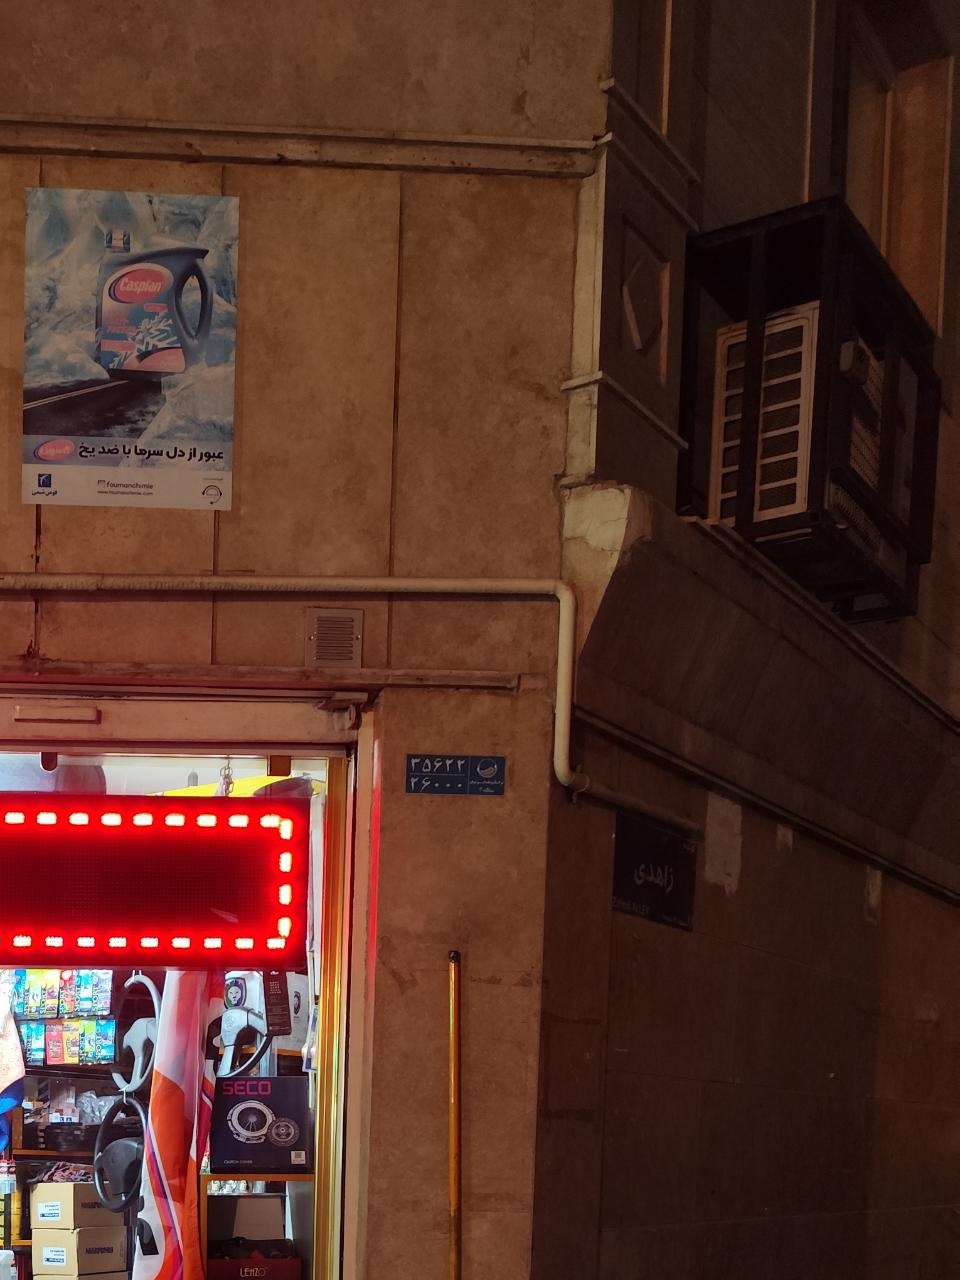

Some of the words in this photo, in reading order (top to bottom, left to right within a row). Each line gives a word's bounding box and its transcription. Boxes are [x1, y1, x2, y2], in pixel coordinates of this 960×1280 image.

[119, 277, 163, 295] Caspian
[78, 442, 95, 458] یخ
[98, 444, 119, 455] ضد
[122, 444, 131, 458] با
[134, 445, 163, 459] سرما
[166, 446, 185, 459] دل
[187, 447, 197, 461] از
[198, 448, 224, 463] عبور
[634, 863, 674, 893] زاهدی
[222, 1081, 271, 1095] SECO
